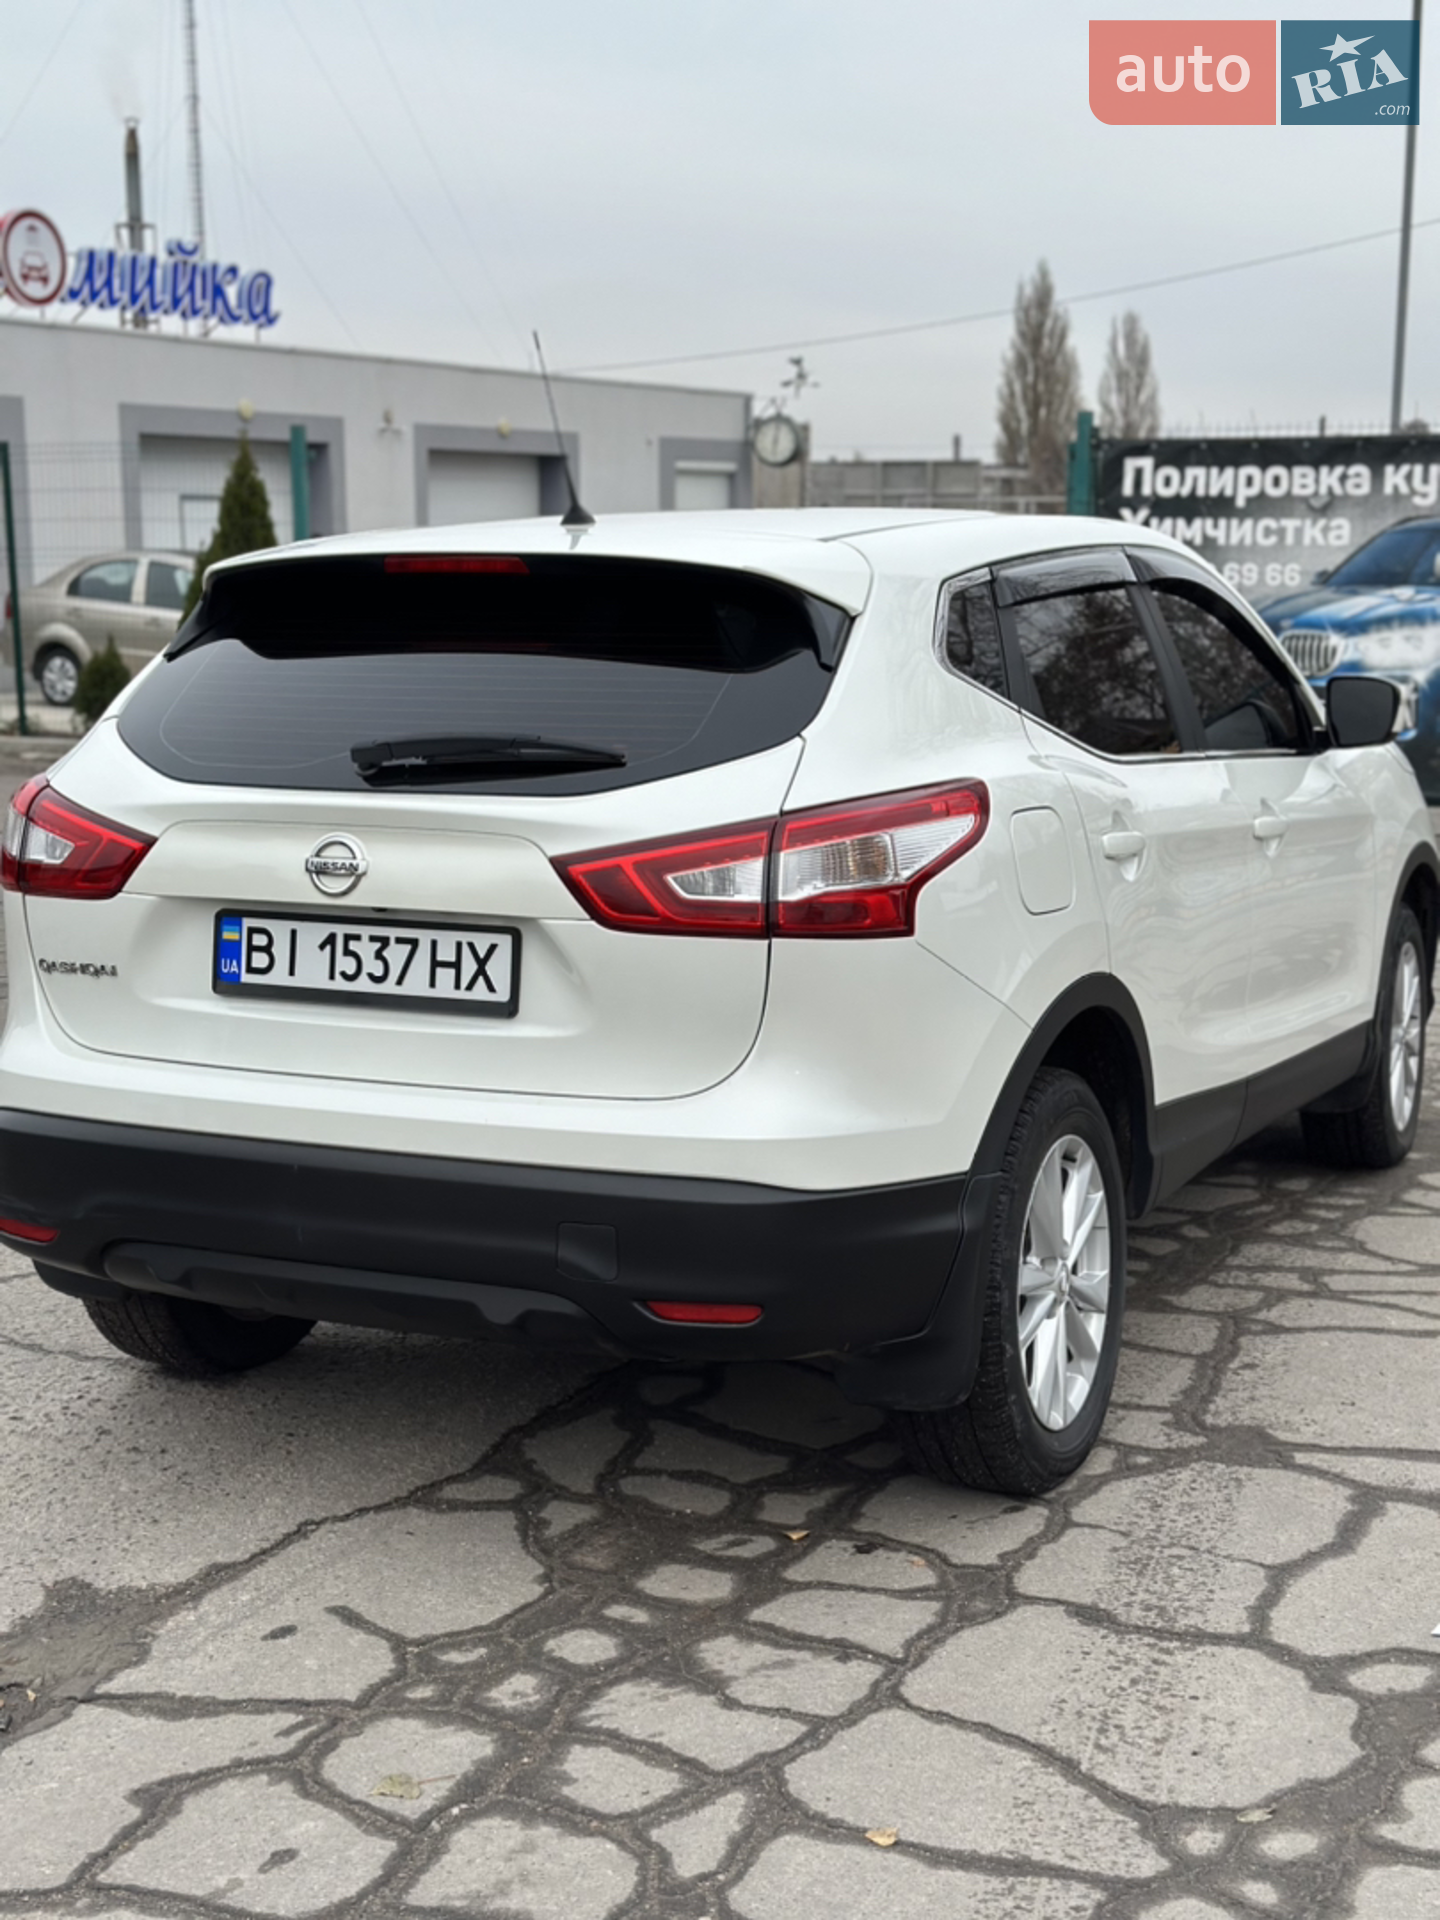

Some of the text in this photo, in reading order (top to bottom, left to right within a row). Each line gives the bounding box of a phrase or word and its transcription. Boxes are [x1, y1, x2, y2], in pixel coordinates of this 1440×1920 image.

[62, 239, 281, 328] мийка
[1121, 456, 1440, 509] Полировка ку
[1222, 562, 1301, 587] 69 66
[309, 860, 360, 873] NISSAN
[38, 957, 118, 978] QASHQAI
[221, 958, 239, 974] UA
[245, 926, 499, 994] BI 1537 HX
